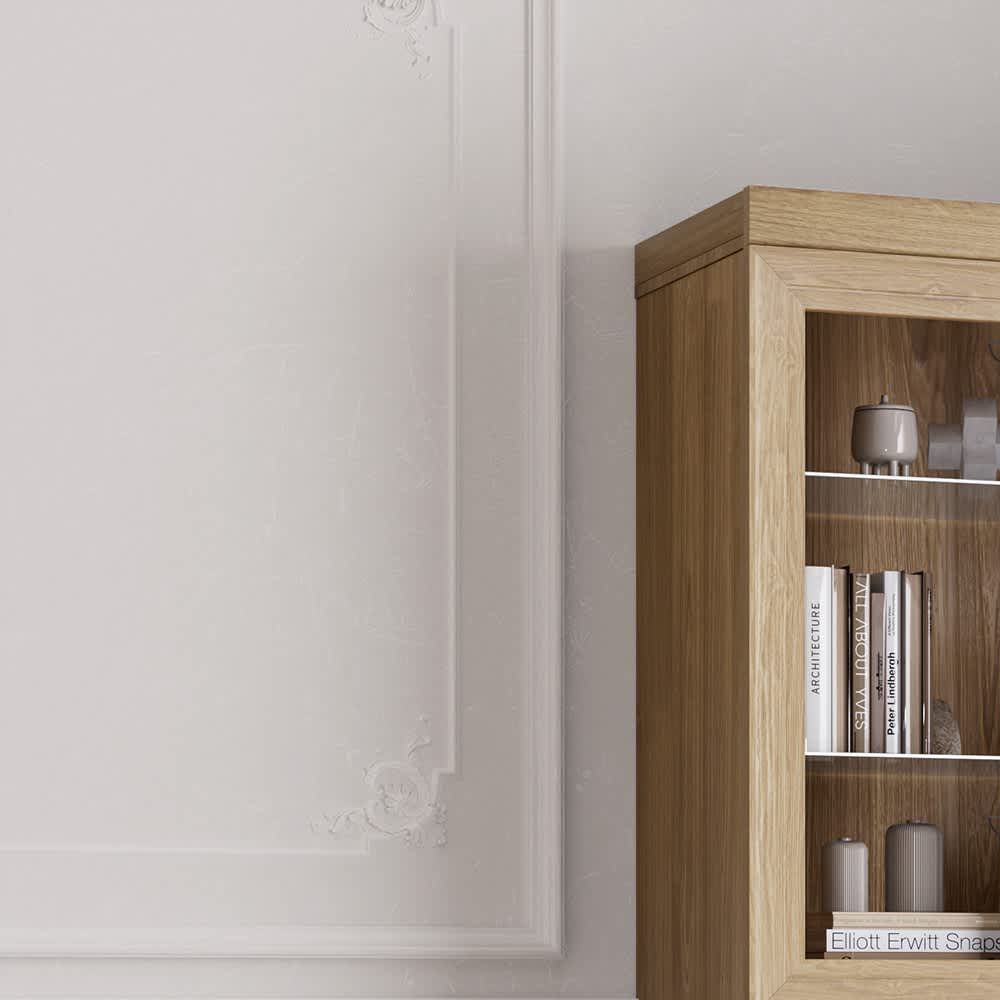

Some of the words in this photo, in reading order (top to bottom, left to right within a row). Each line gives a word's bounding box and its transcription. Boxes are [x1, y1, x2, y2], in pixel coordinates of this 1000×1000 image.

[855, 580, 869, 612] ALL
[811, 602, 821, 695] ARCHITECTURE
[855, 618, 869, 676] ABOUT
[887, 651, 899, 705] Lindbergh
[855, 688, 869, 730] YVES
[887, 707, 895, 736] Peter
[831, 932, 881, 951] Elliott
[887, 932, 940, 951] Erwitt
